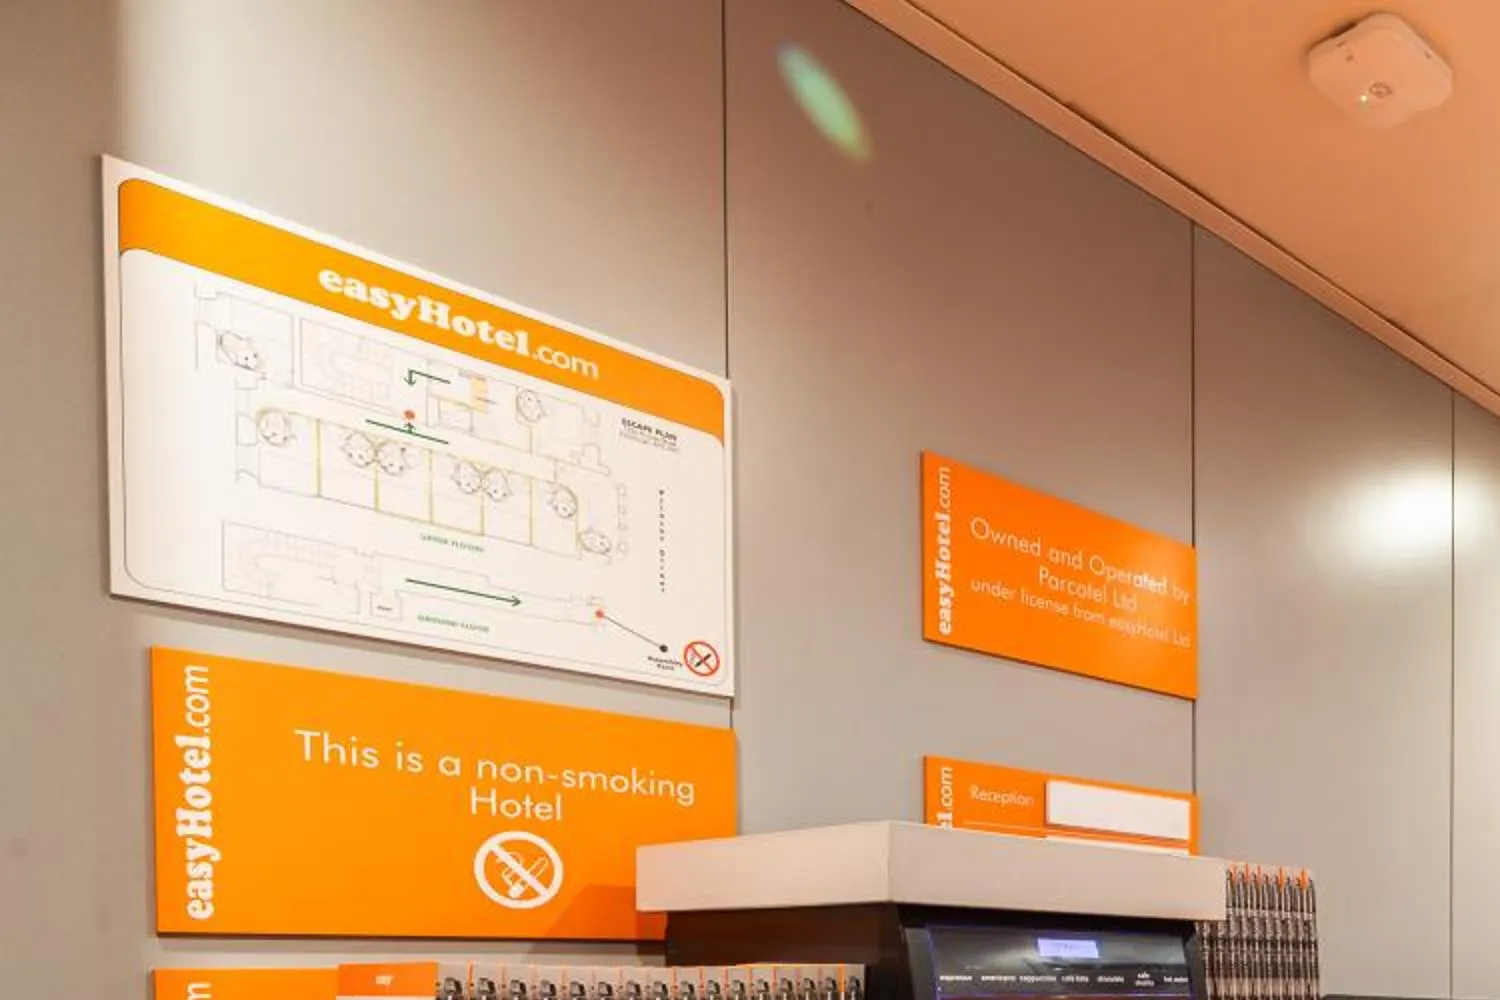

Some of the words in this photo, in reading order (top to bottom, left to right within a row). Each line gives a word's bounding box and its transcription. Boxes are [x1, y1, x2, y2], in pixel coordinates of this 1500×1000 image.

[317, 269, 600, 380] easyHotel.com
[934, 466, 954, 636] easyHotel.com
[970, 517, 1041, 557] Owned
[1049, 547, 1083, 570] and
[1089, 554, 1168, 595] Operated
[1172, 582, 1189, 606] by
[971, 577, 1015, 600] under
[1021, 587, 1069, 616] license
[1073, 603, 1106, 625] from
[1113, 588, 1138, 613] Ltd
[175, 664, 221, 921] easyHotel.com
[294, 729, 380, 769] This
[396, 740, 425, 774] is
[438, 755, 462, 778] a
[476, 755, 696, 807] non-smoking
[470, 787, 563, 822] Hotel
